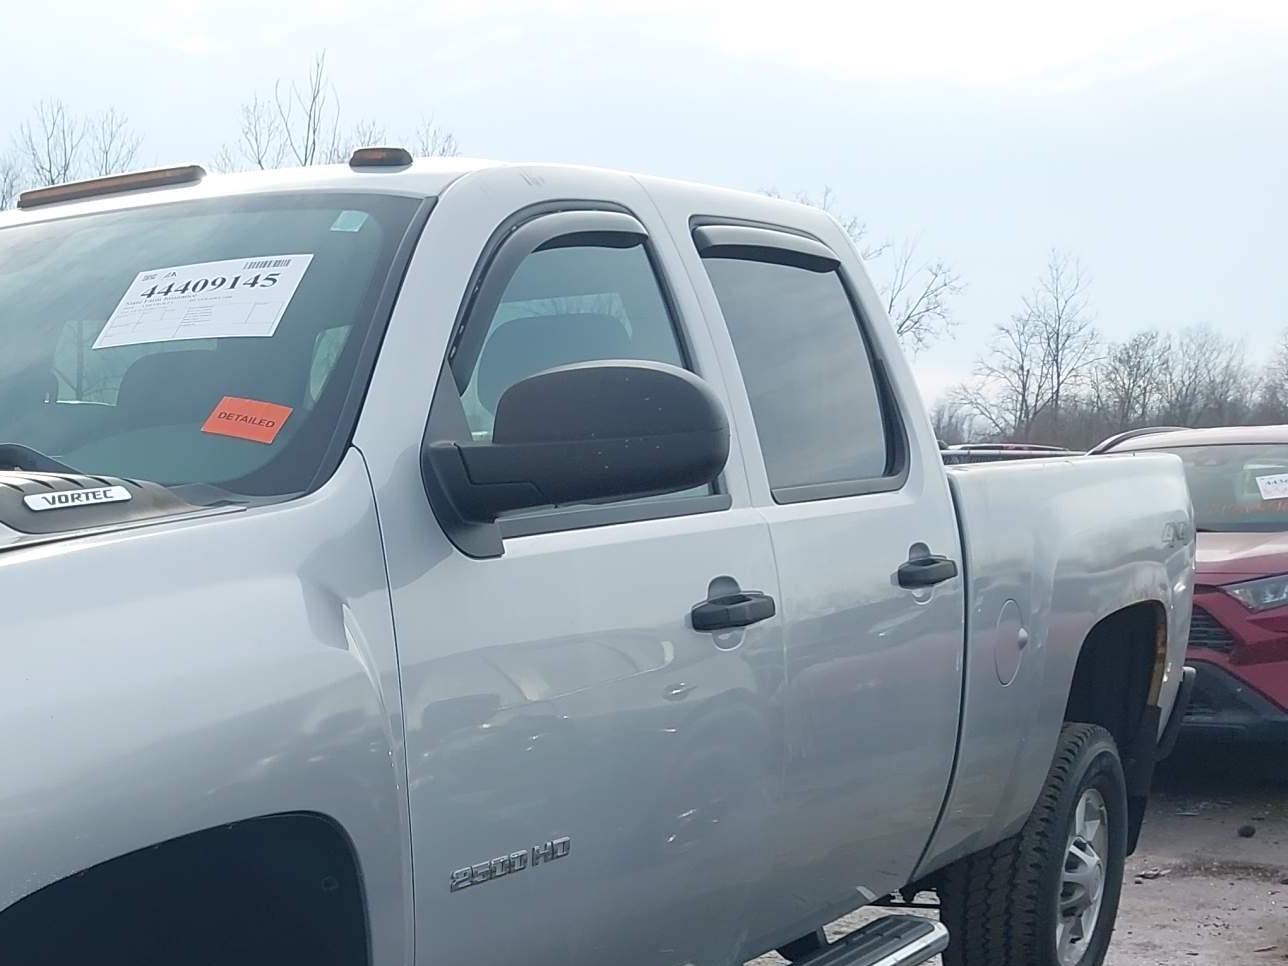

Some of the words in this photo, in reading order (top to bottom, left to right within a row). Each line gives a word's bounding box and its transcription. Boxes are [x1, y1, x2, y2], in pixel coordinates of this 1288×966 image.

[140, 272, 281, 299] 44409145
[217, 411, 276, 428] DETAILED
[41, 489, 115, 506] VORTEC
[449, 849, 529, 893] 2500
[531, 836, 572, 868] HD
